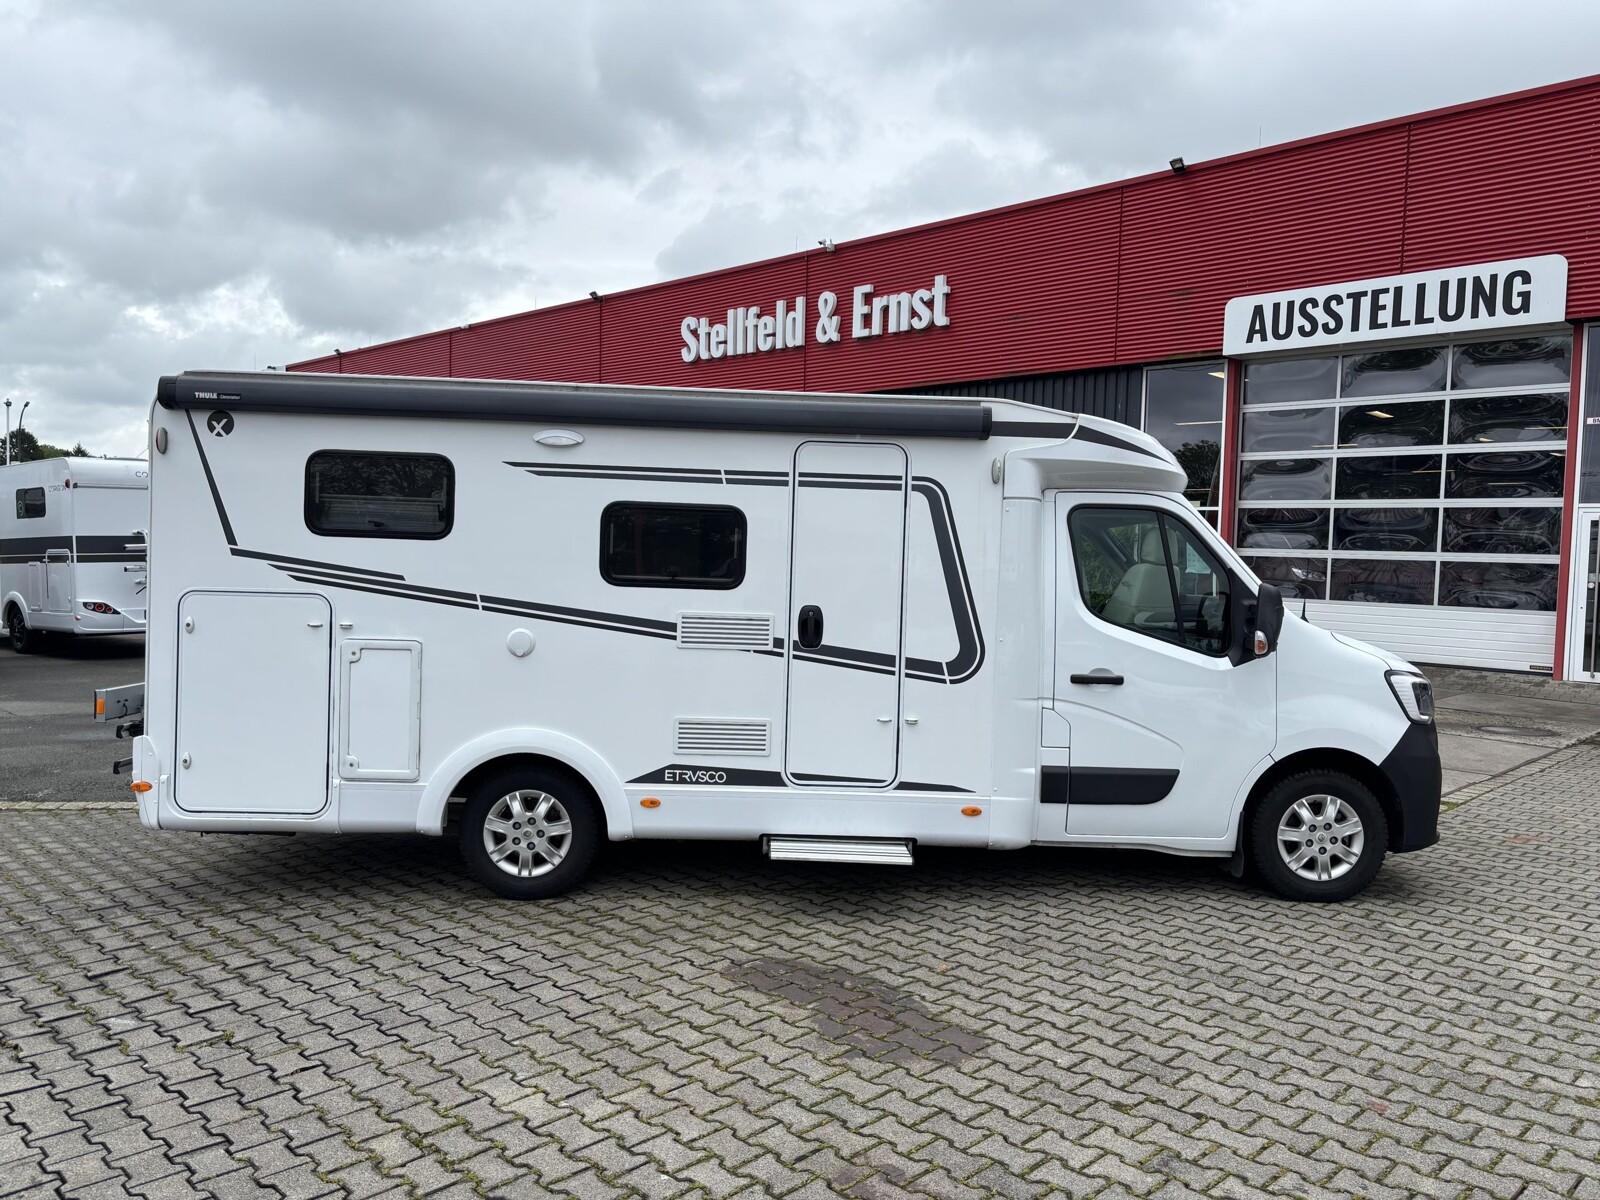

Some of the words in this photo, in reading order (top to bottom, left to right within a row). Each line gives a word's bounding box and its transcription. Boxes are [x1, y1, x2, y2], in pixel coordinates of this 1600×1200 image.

[681, 296, 806, 363] Stellfeld
[815, 291, 841, 343] &
[852, 274, 951, 338] Ernst
[1246, 269, 1532, 343] AUSSTELLUNG
[194, 391, 218, 399] THULE
